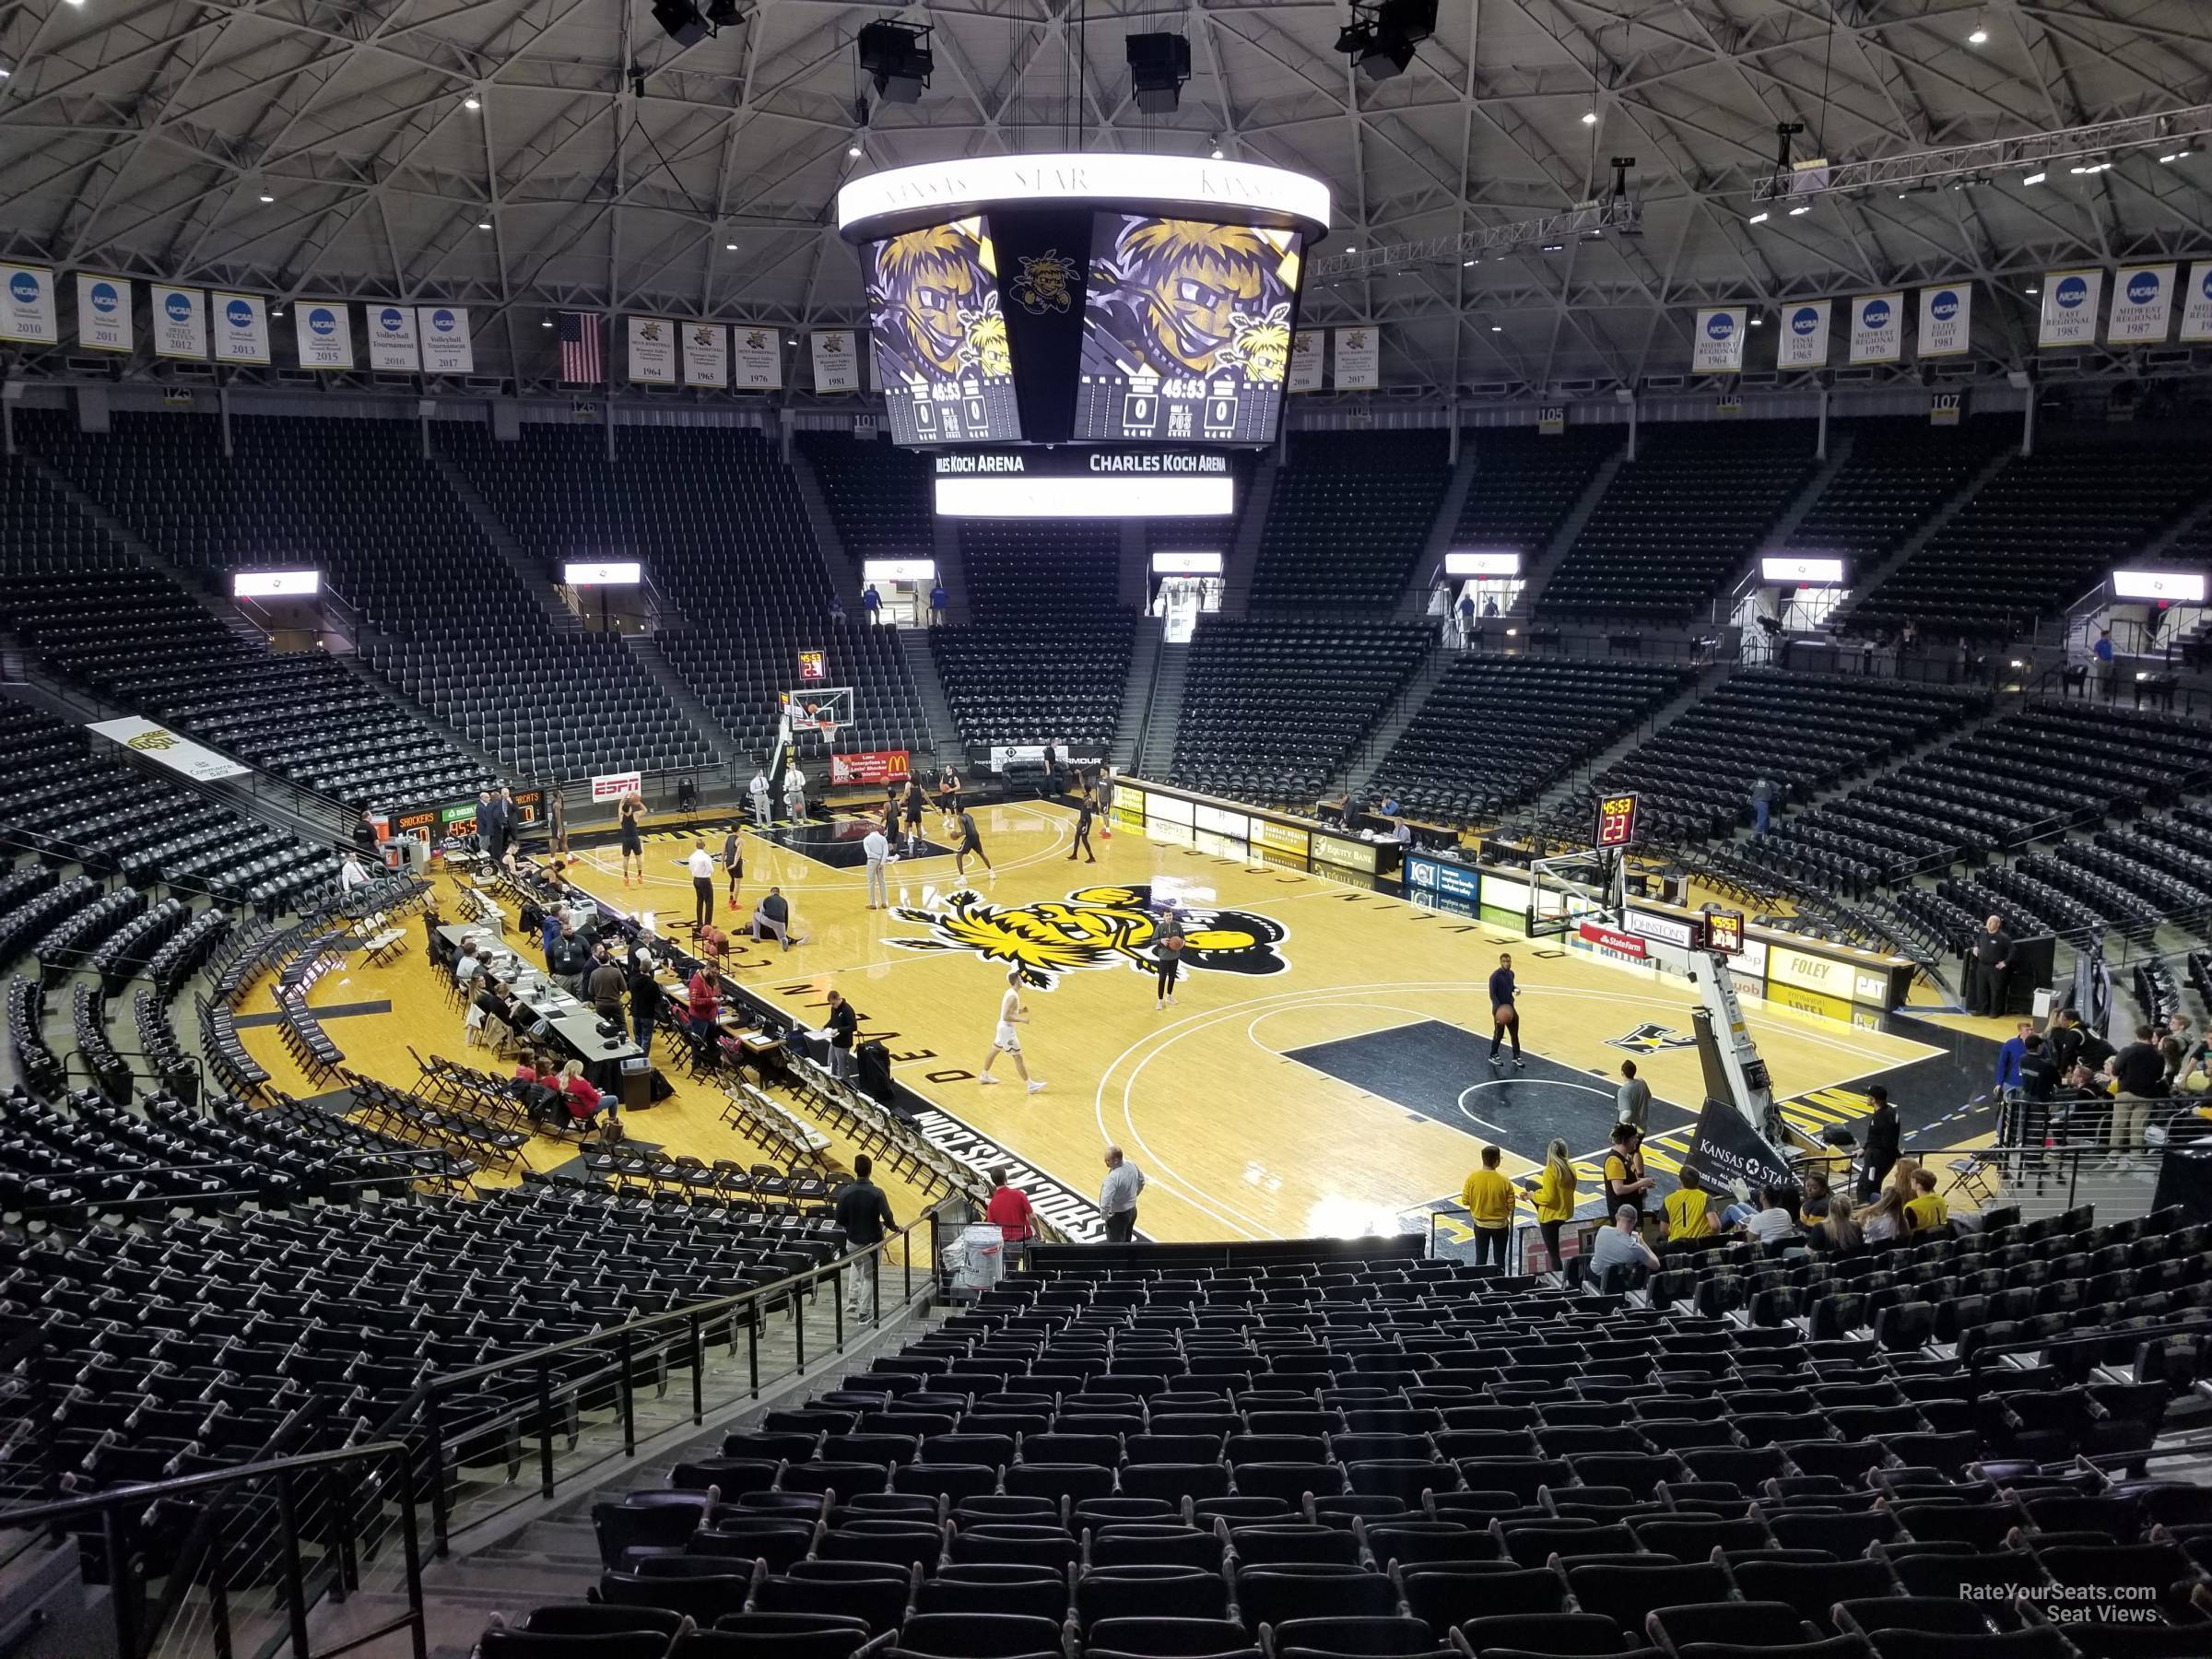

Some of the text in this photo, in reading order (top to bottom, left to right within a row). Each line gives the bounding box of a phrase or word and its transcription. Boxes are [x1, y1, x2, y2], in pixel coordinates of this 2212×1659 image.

[2058, 291, 2087, 301] NCAA
[2130, 287, 2159, 297] NCAA
[168, 305, 192, 315] NCAA
[1934, 304, 1958, 313] NCAA
[2120, 306, 2162, 315] MIDWEST
[229, 312, 253, 322] NCAA
[1865, 313, 1889, 323] NCAA
[2046, 317, 2090, 326] REGIONAL
[2116, 313, 2162, 323] REGIONAL
[17, 323, 41, 333] 2010
[312, 320, 335, 328] NCAA
[1794, 319, 1818, 329] NCAA
[2125, 324, 2151, 334] 1987
[1710, 325, 1733, 334] NCAA
[96, 332, 118, 342] 2011
[376, 332, 409, 340] Volleyball
[170, 339, 192, 350] 2012
[372, 341, 414, 349] Tournament
[1855, 337, 1894, 346] REGIONAL
[1934, 337, 1954, 347] 1981
[232, 345, 255, 355] 2013
[1865, 346, 1886, 355] 1976
[315, 352, 338, 361] 2015
[1708, 356, 1727, 364] 1964
[1793, 351, 1812, 360] 1965
[384, 357, 406, 366] 2016
[439, 359, 458, 367] 2017
[642, 368, 661, 376] 1964
[697, 371, 714, 381] 1965
[932, 382, 960, 401] 45:53
[1162, 379, 1206, 399] 45:53
[1934, 394, 1960, 409] 107
[971, 400, 980, 420] 0
[1135, 398, 1147, 419] 0
[1217, 401, 1227, 421] 0
[1541, 407, 1564, 420] 105
[921, 405, 929, 424] 0
[855, 416, 876, 427] 101
[1169, 415, 1192, 430] POS
[951, 455, 1024, 472] KOCH ARENA
[1089, 454, 1226, 472] CHARLES KOCH ARENA
[800, 653, 821, 663] 45:53
[190, 764, 232, 775] Commerce
[209, 770, 229, 778] Bank
[594, 778, 639, 795] ESPN
[1604, 798, 1630, 815] 45:53
[399, 812, 435, 828] SHOCKERS
[450, 820, 477, 837] 45:5
[525, 806, 533, 822] 0
[1603, 815, 1625, 841] 23
[1287, 831, 1308, 841] HEALTH
[1327, 845, 1351, 859] EQUITY
[1353, 851, 1372, 864] BANK
[1627, 912, 1686, 940] JOHNSTON'S
[1711, 915, 1737, 930] 45:53
[1791, 958, 1830, 980] FOLEY
[1856, 975, 1887, 999] CAT
[1700, 1138, 1744, 1169] KANSAS
